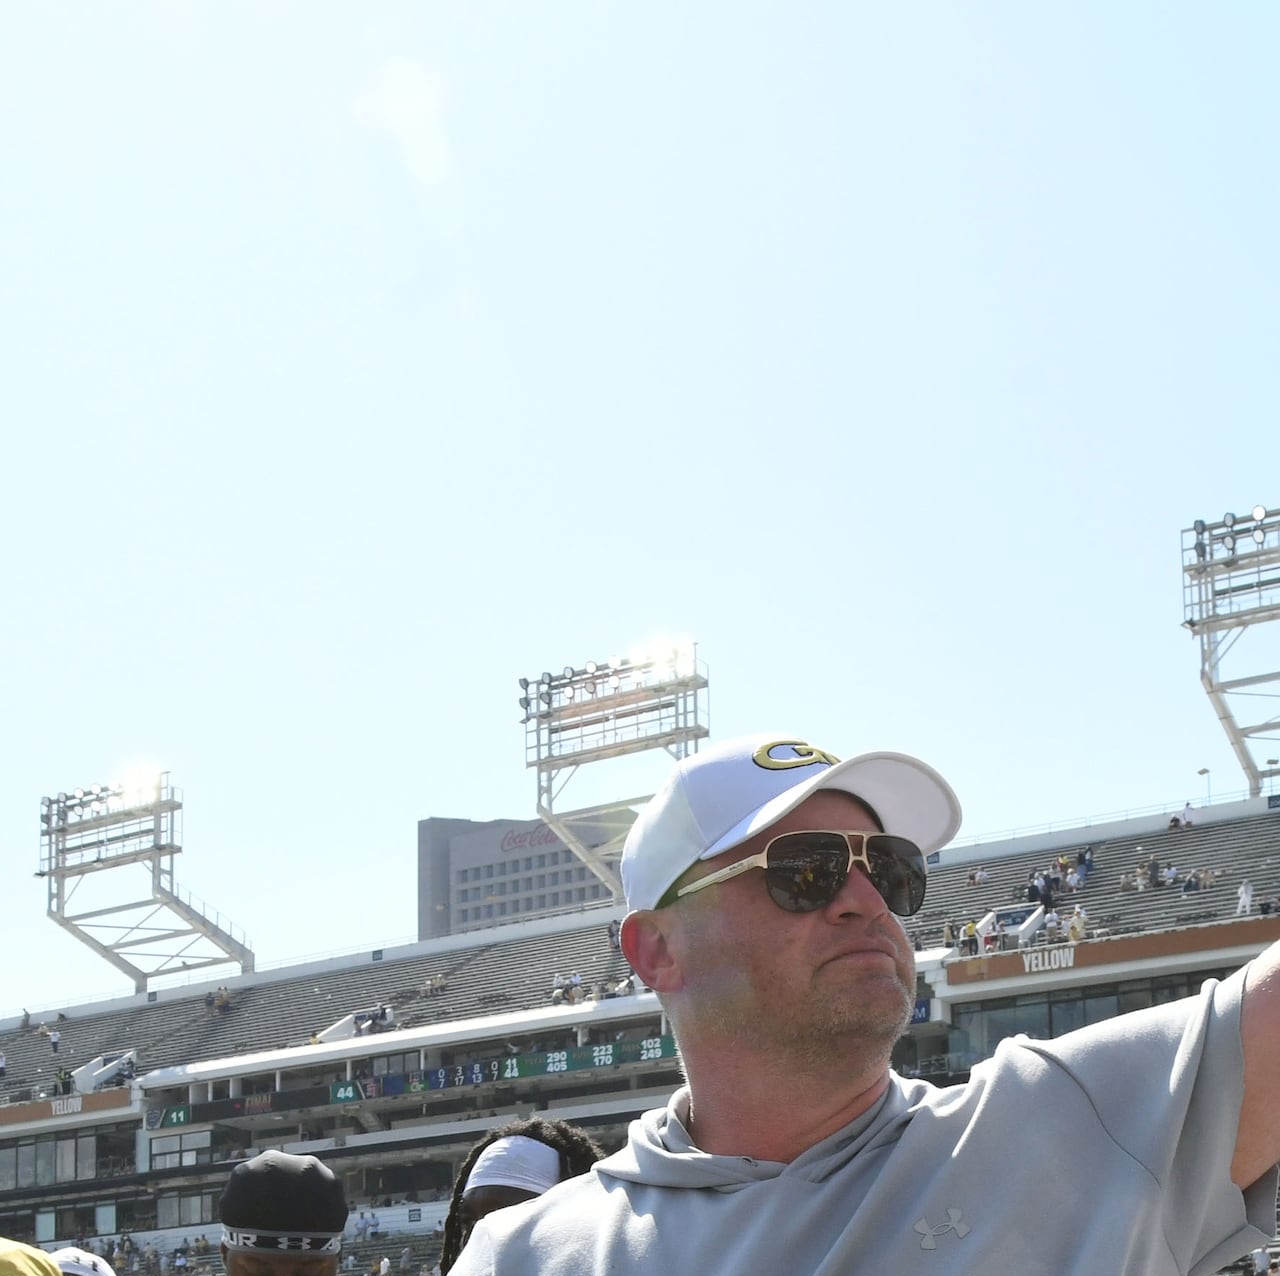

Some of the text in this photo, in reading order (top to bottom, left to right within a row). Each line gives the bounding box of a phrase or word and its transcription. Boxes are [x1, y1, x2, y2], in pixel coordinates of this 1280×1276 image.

[1023, 947, 1075, 973] YELLOW
[640, 1038, 661, 1049] 102
[592, 1045, 613, 1056] 223
[640, 1049, 662, 1060] 249
[546, 1051, 567, 1062] 290
[593, 1056, 612, 1066] 170
[504, 1068, 519, 1078] 44
[547, 1062, 567, 1073] 405
[337, 1086, 353, 1099] 44
[50, 1096, 82, 1115] YELLOW
[170, 1111, 185, 1123] 11
